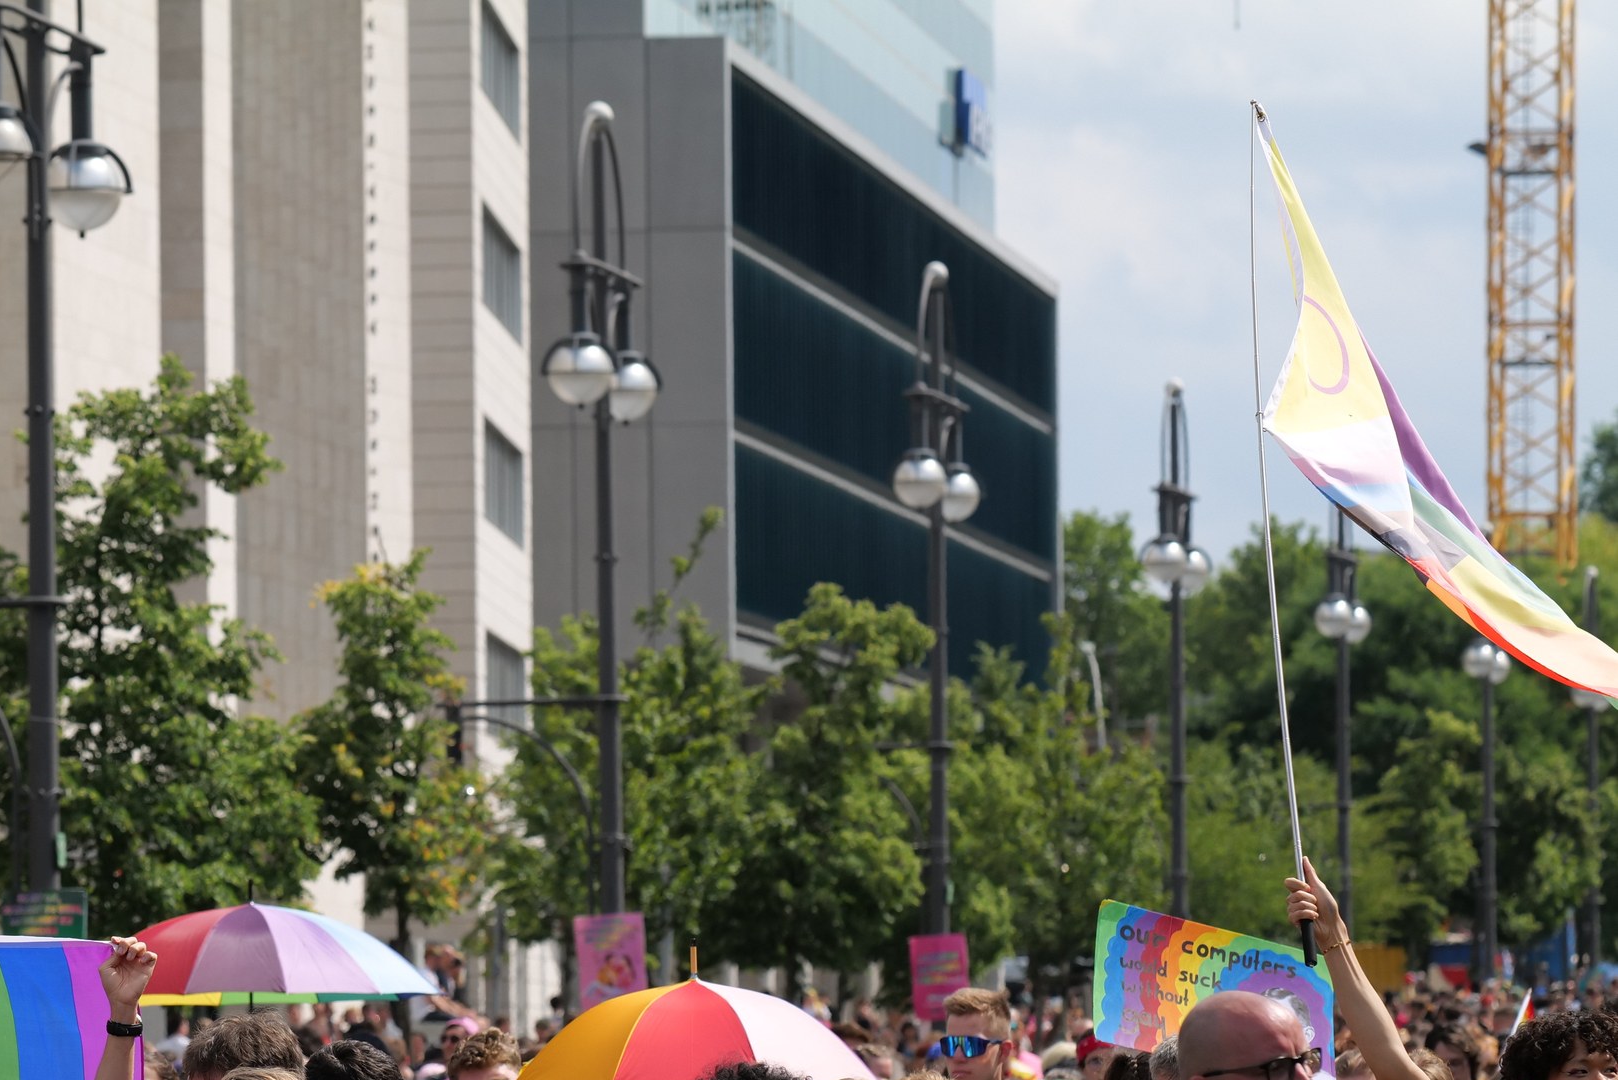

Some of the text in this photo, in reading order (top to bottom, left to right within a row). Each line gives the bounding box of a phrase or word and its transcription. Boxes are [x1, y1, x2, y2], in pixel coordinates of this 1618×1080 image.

[1120, 957, 1222, 990] would suck
[1182, 941, 1297, 978] computers
[1122, 981, 1189, 1006] without
[1119, 1009, 1166, 1040] gay
